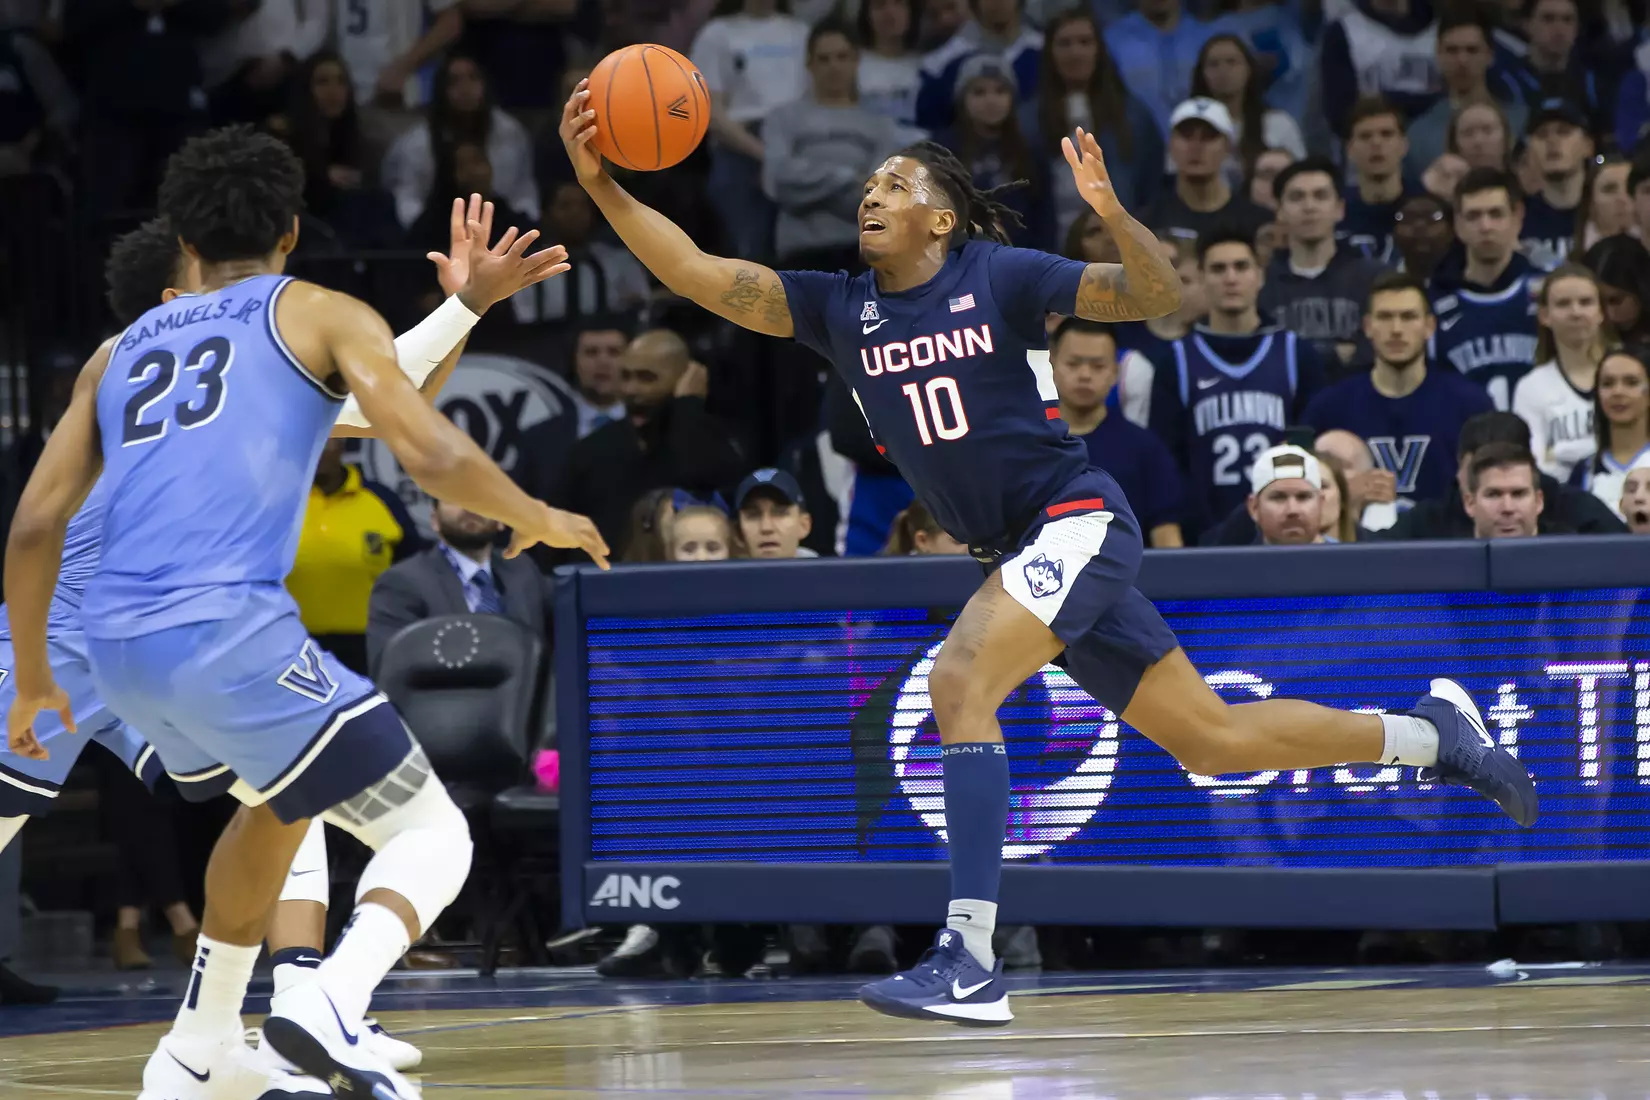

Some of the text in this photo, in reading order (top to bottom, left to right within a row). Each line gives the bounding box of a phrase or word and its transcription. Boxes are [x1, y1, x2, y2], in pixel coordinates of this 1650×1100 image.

[120, 298, 262, 351] SAMUELS JR
[861, 324, 994, 376] UCONN
[121, 336, 235, 447] 23
[901, 376, 970, 446] 10
[1193, 390, 1285, 436] VILLANOVA
[1368, 435, 1431, 493] V
[277, 638, 340, 703] V
[589, 873, 681, 910] ANC
